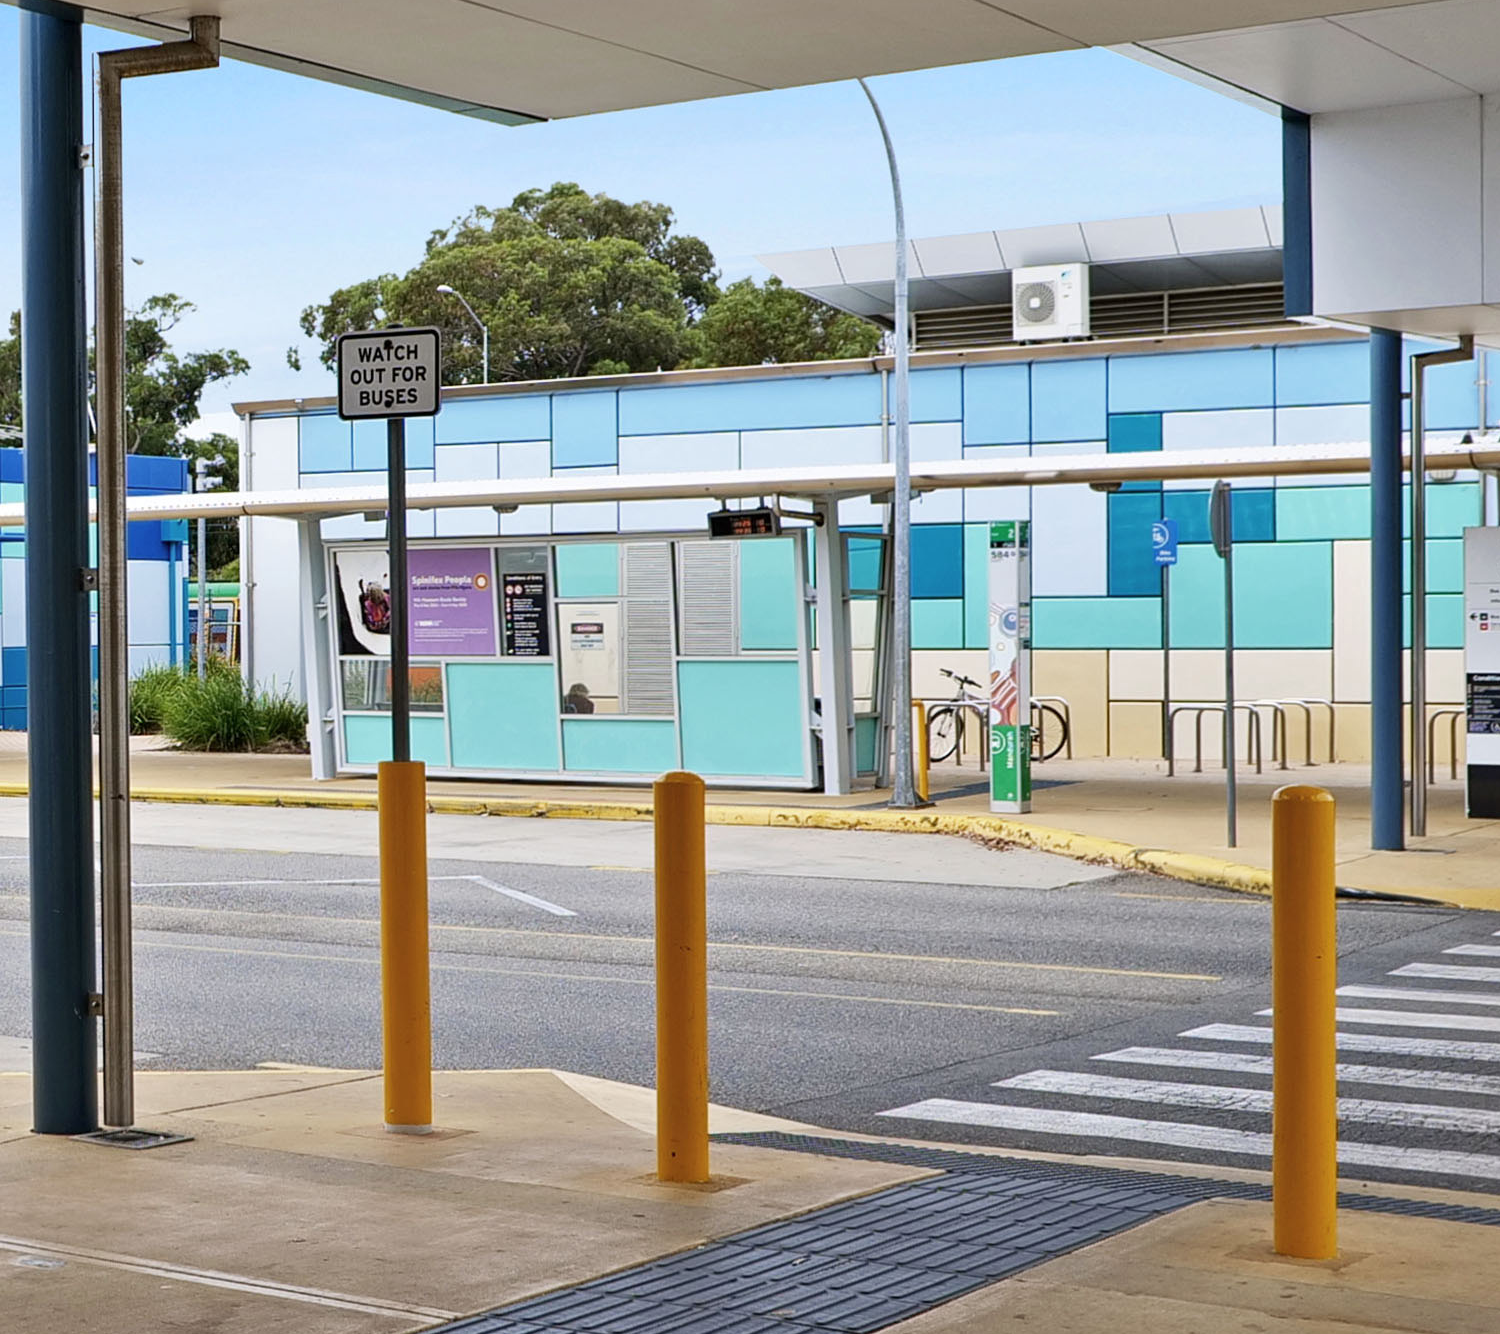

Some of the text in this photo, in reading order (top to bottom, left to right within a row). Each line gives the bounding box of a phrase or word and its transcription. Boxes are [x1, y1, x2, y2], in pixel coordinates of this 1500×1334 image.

[358, 343, 418, 363] WATCH
[350, 366, 427, 385] OUT FOR
[360, 388, 418, 407] BUSES
